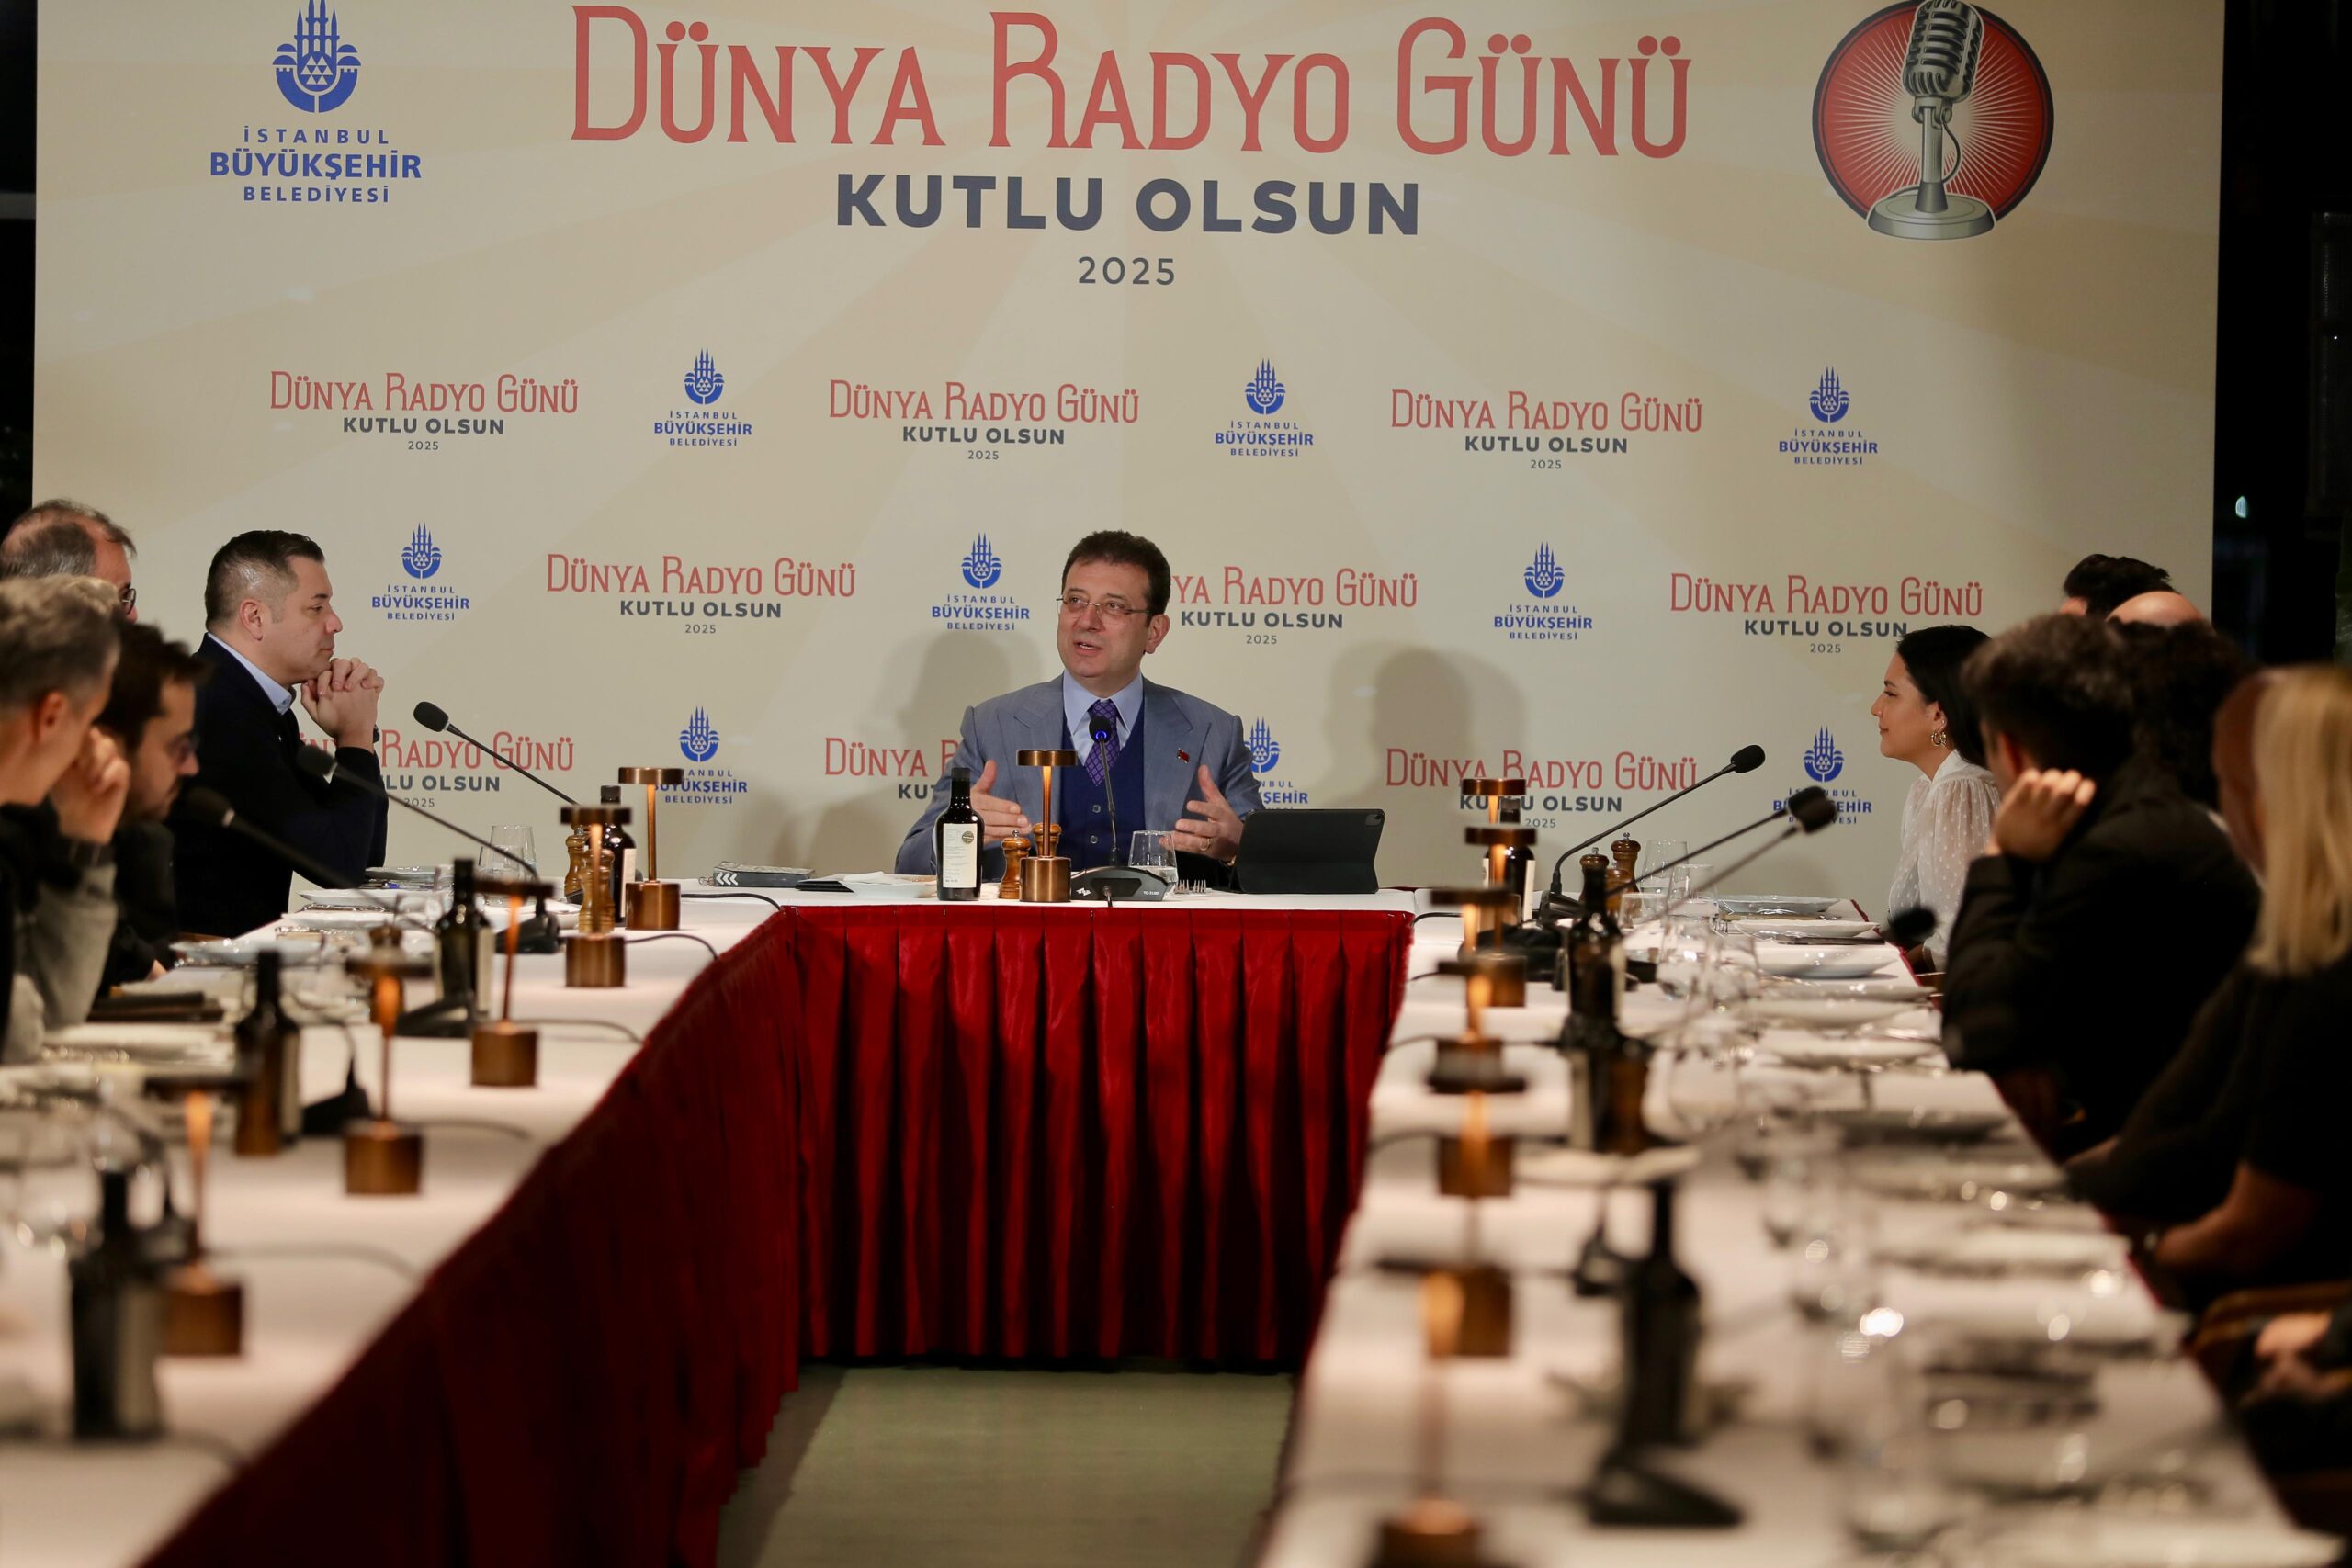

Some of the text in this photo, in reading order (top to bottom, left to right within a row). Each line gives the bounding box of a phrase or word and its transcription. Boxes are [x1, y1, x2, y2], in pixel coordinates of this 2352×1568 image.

[571, 6, 1691, 159] DÜNYA RADYO GÜNÜ
[244, 126, 388, 144] İSTANBUL
[211, 148, 421, 180] BÜYÜKŞEHİR
[244, 185, 388, 202] BELEDİYESİ
[838, 174, 1418, 235] KUTLU OLSUN
[1079, 256, 1174, 285] 2025
[271, 371, 578, 413] DÜNYA RADYO GÜNÜ
[830, 380, 1138, 423] DÜNYA RADYO GÜNÜ
[670, 411, 737, 419] İSTANBUL
[1392, 389, 1702, 432] DÜNYA RADYO GÜNÜ
[344, 417, 503, 434] KUTLU OLSUN
[655, 421, 752, 435] BÜYÜKŞEHİR
[1231, 421, 1298, 429] İSTANBUL
[903, 426, 1064, 444] KUTLU OLSUN
[1216, 431, 1313, 446] BÜYÜKŞEHİR
[1795, 429, 1862, 437] İSTANBUL
[408, 441, 438, 450] 2025
[670, 438, 736, 446] BELEDİYESİ
[1465, 436, 1627, 453] KUTLU OLSUN
[1780, 440, 1877, 454] BÜYÜKŞEHİR
[968, 450, 999, 459] 2025
[1231, 448, 1298, 457] BELEDİYESİ
[1531, 459, 1561, 469] 2025
[1794, 457, 1862, 465] BELEDİYESİ
[548, 554, 855, 597] DÜNYA RADYO GÜNÜ
[388, 585, 454, 593] İSTANBUL
[1224, 567, 1323, 605] RADYO
[1337, 569, 1417, 607] GÜNÜ
[1671, 573, 1982, 616] DÜNYA RADYO GÜNÜ
[372, 595, 469, 609] BÜYÜKŞEHİR
[948, 594, 1014, 604] İSTANBUL
[388, 612, 454, 620] BELEDİYESİ
[621, 601, 781, 617] KUTLU OLSUN
[933, 604, 1029, 620] BÜYÜKŞEHİR
[1510, 604, 1577, 613] İSTANBUL
[947, 622, 1014, 630] BELEDİYESİ
[1182, 611, 1342, 628] KUTLU OLSUN
[1495, 615, 1592, 629] BÜYÜKŞEHİR
[685, 624, 716, 634] 2025
[1745, 620, 1908, 637] KUTLU OLSUN
[1247, 635, 1277, 644] 2025
[1811, 644, 1841, 653] 2025
[381, 729, 481, 769] RADYO
[492, 731, 574, 771] GÜNÜ
[825, 738, 929, 777] DÜNYA
[684, 769, 733, 777] ANBUL
[1615, 751, 1698, 791] GÜNÜ
[422, 775, 500, 792] OLSUN
[665, 795, 733, 805] BELEDİYESİ
[1263, 790, 1308, 804] ŞEHİR
[1460, 795, 1623, 813] KUU OLSUN
